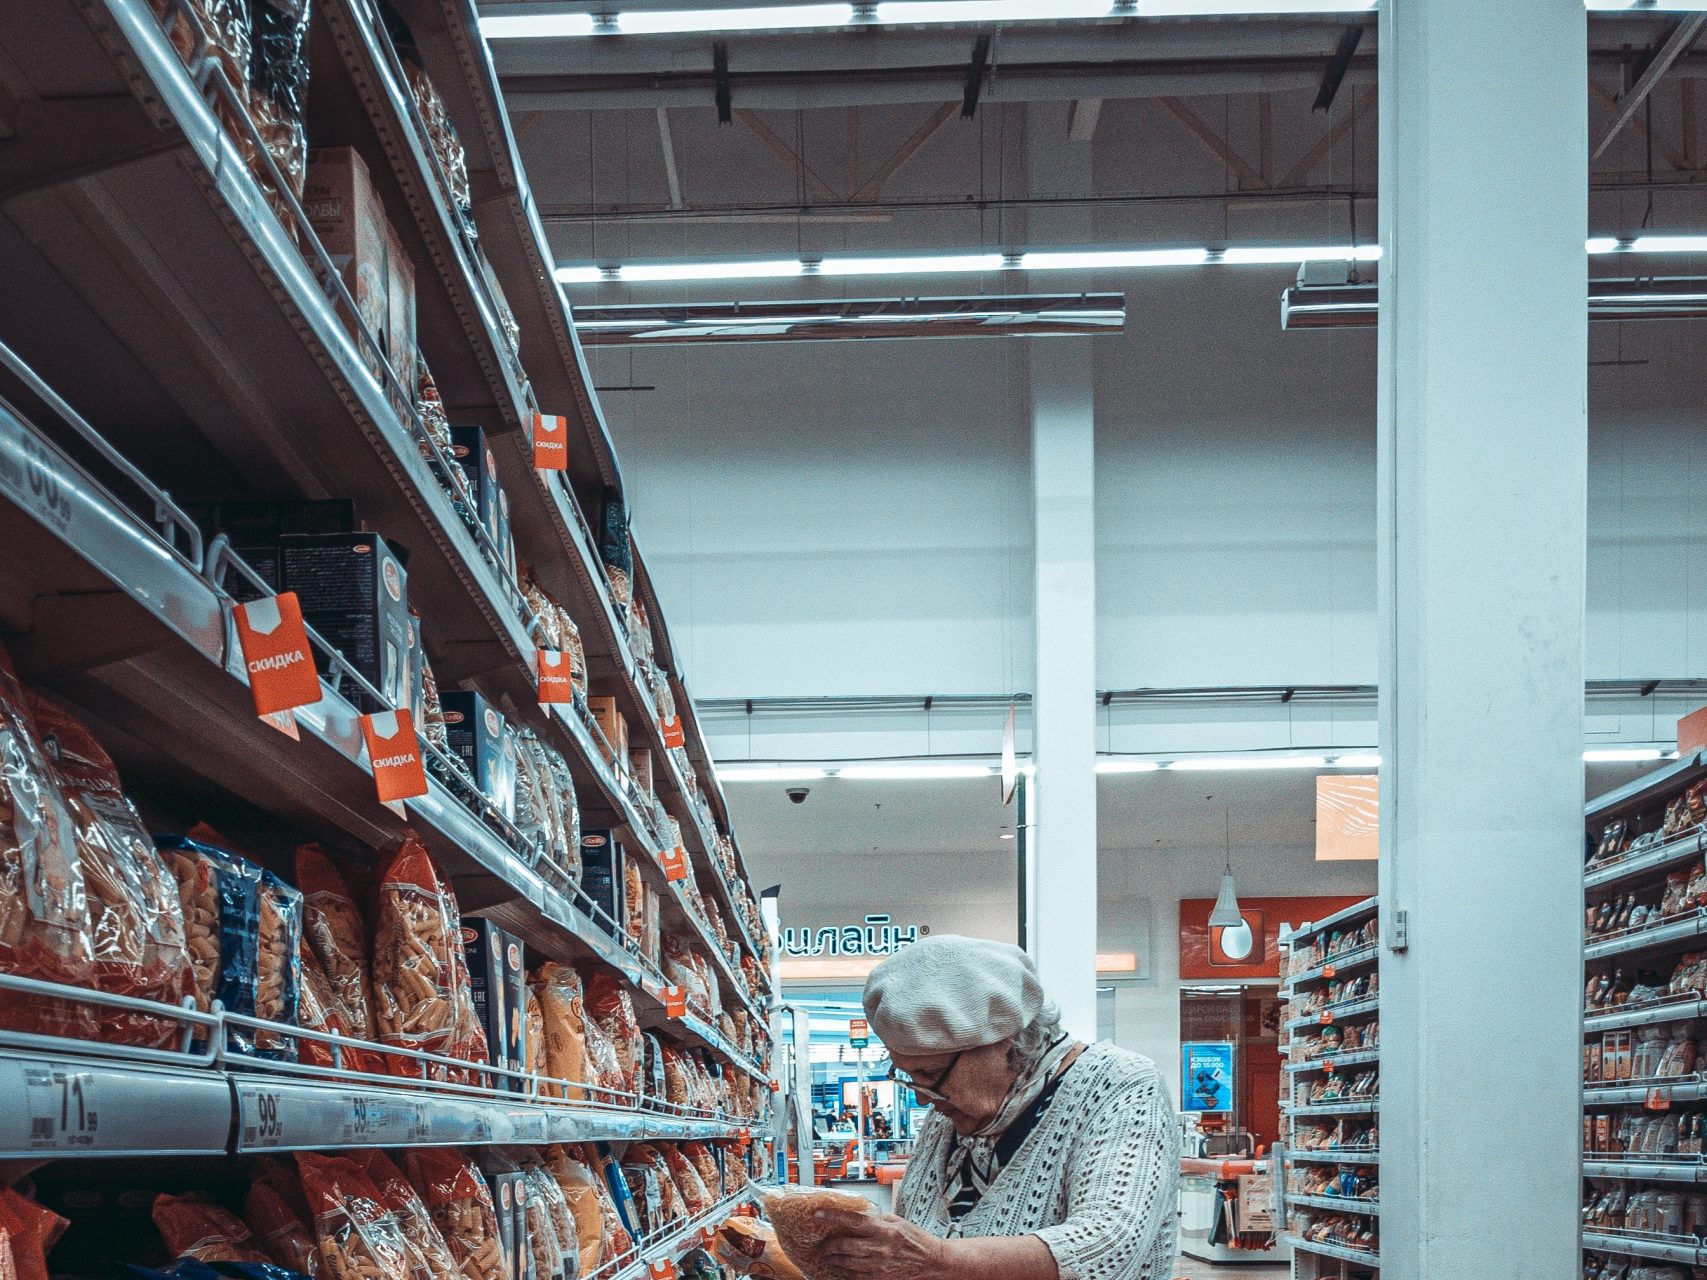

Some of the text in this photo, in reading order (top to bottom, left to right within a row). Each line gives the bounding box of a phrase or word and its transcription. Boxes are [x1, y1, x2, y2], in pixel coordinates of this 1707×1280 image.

[248, 650, 305, 673] СКИДКА
[539, 676, 567, 684] СКИДКА
[373, 753, 416, 770] СКИДКА
[53, 1073, 85, 1132] 71
[258, 1093, 276, 1137] 99
